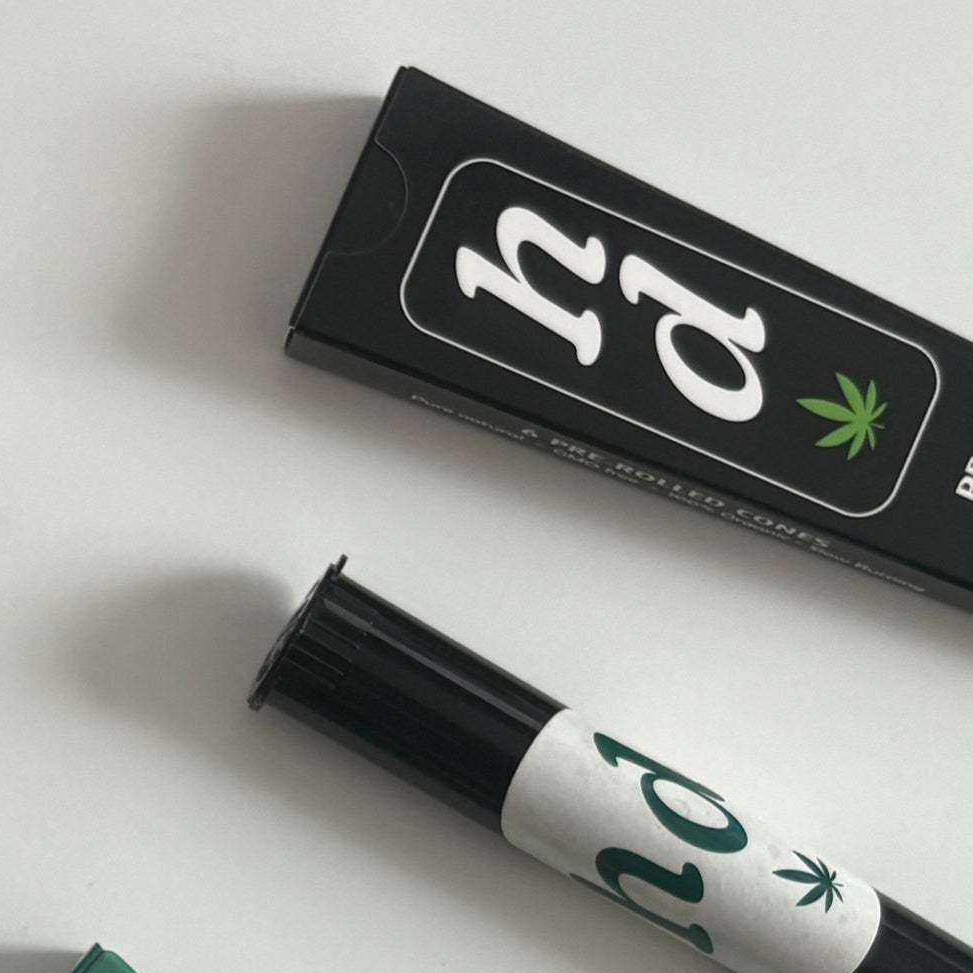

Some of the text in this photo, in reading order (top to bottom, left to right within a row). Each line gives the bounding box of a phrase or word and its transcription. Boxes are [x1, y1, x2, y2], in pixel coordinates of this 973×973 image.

[455, 206, 607, 367] h
[618, 254, 766, 423] d
[736, 508, 830, 548] CONES
